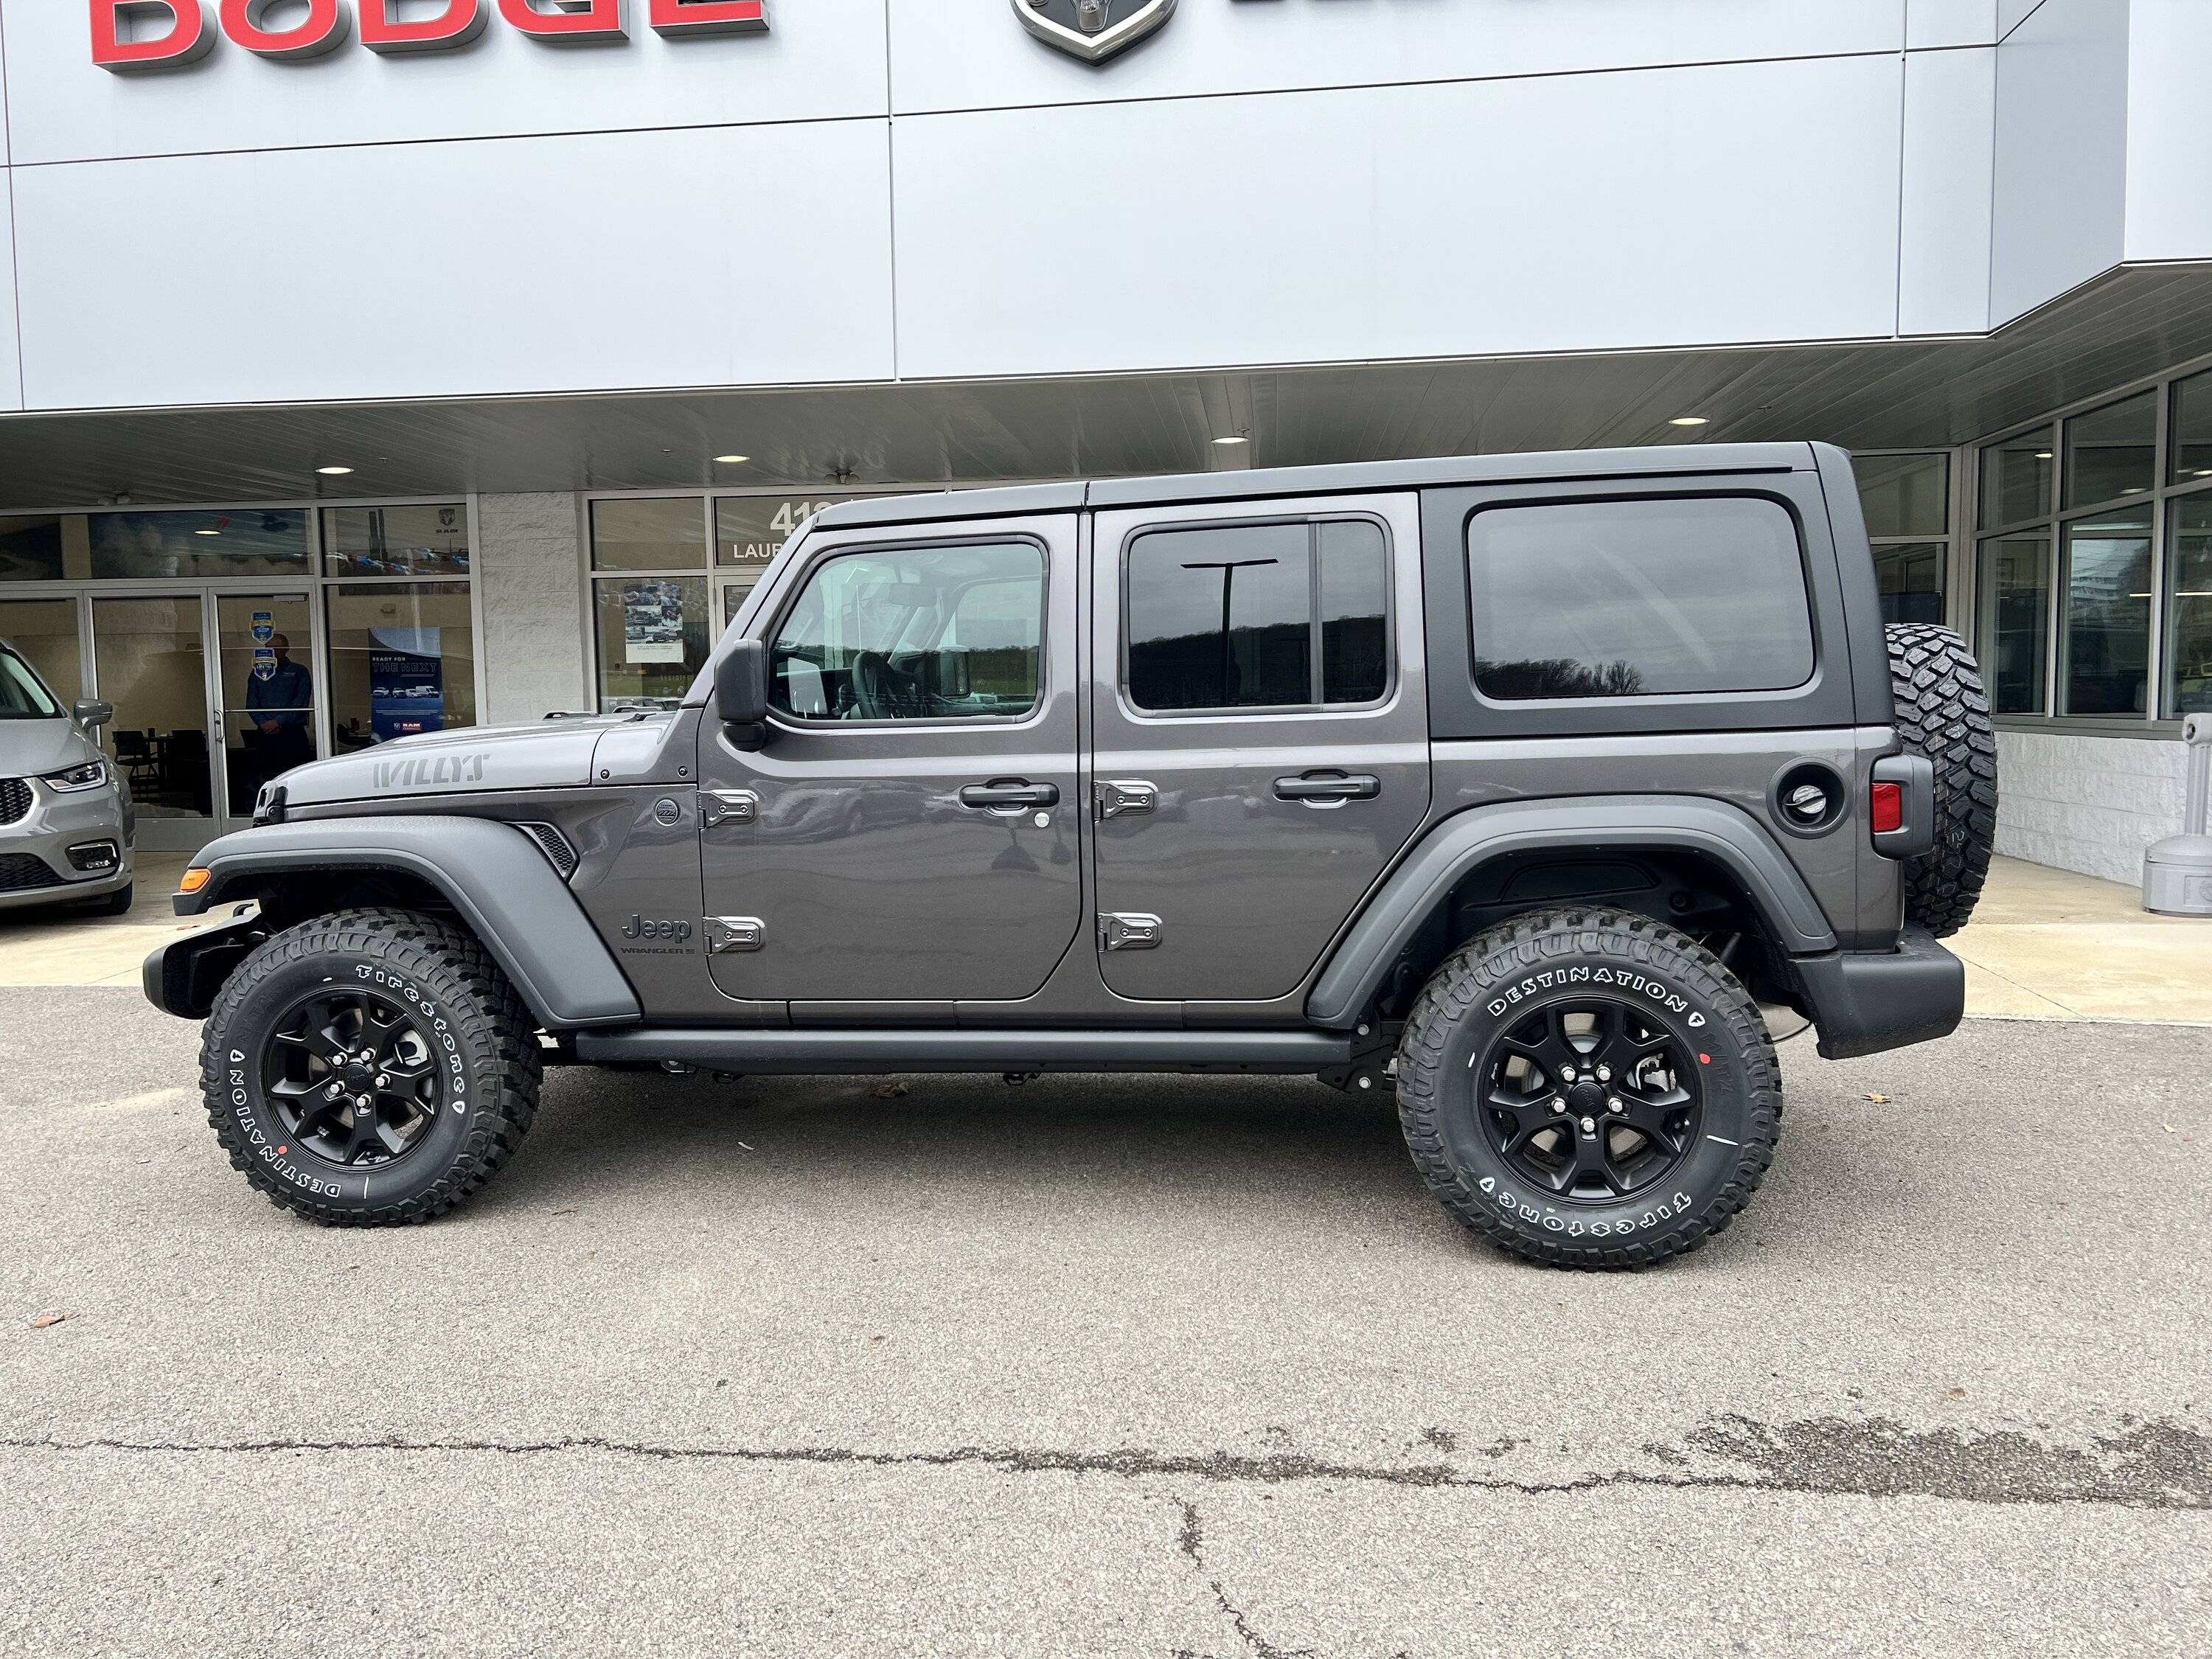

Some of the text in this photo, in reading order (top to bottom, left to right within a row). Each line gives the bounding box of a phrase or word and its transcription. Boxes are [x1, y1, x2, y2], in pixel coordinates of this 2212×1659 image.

[770, 501, 832, 537] 41
[372, 662, 437, 672] THE NEXT
[373, 754, 490, 788] WILLYS
[621, 914, 692, 944] Jeep
[619, 947, 684, 955] WRANGLER
[1486, 967, 1688, 1017] DESTINATION
[229, 1069, 342, 1198] DESTINATION
